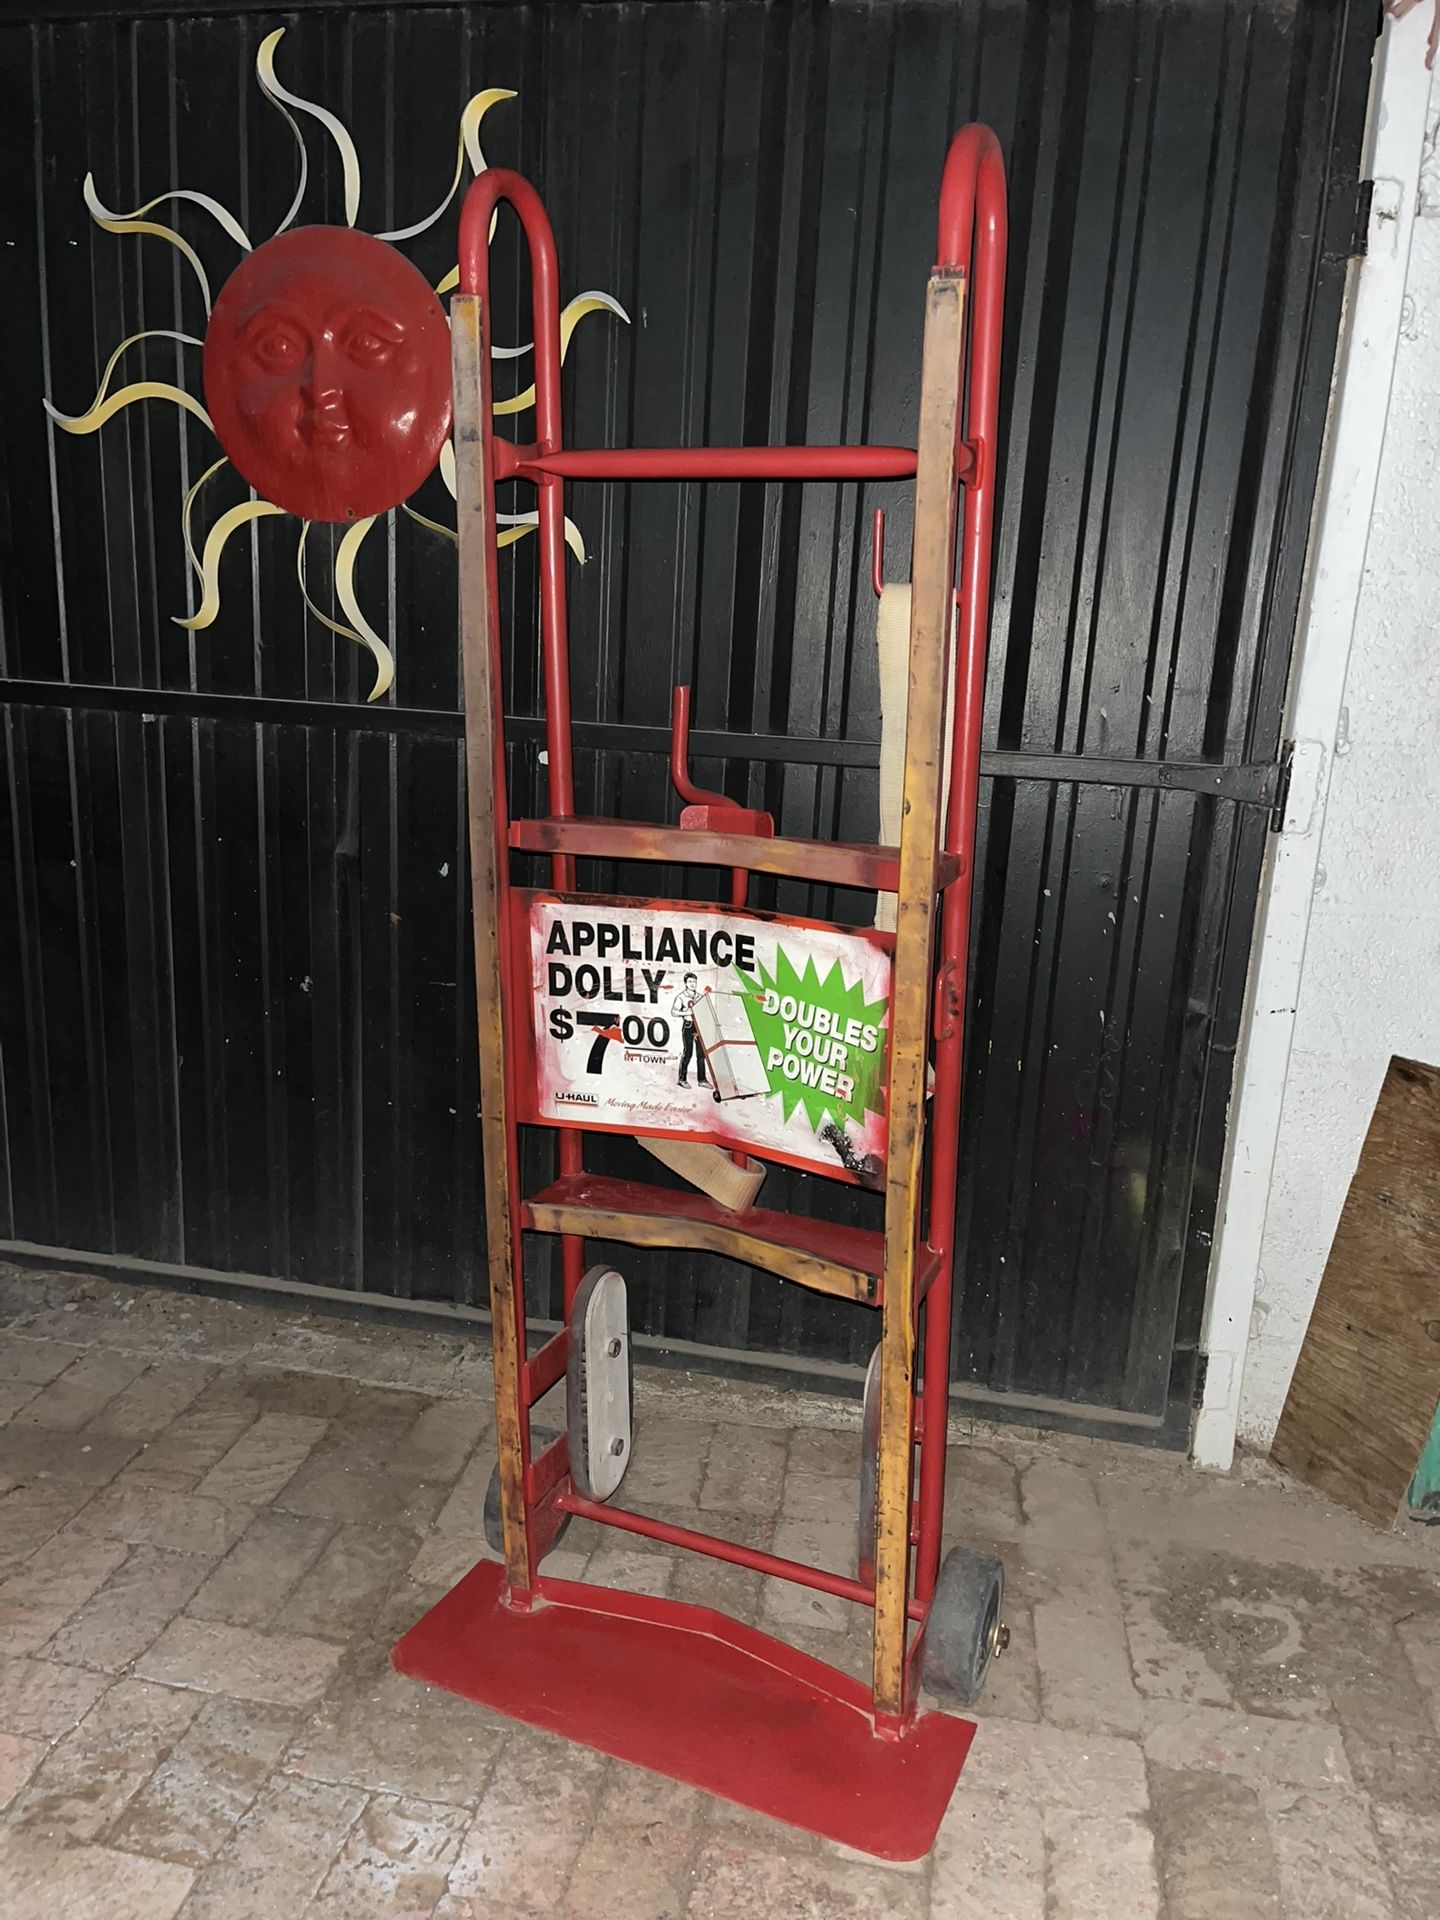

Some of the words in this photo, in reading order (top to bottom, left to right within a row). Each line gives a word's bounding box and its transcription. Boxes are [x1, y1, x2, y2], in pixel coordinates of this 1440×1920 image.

[546, 919, 755, 972] APPLIANCE
[548, 962, 667, 1005] DOLLY
[762, 988, 879, 1053] DOUBLES
[783, 1023, 849, 1072] YOUR
[555, 1091, 598, 1103] U-HAUL
[767, 1046, 856, 1103] POWER
[604, 1097, 637, 1111] Moving
[635, 1101, 663, 1112] Made
